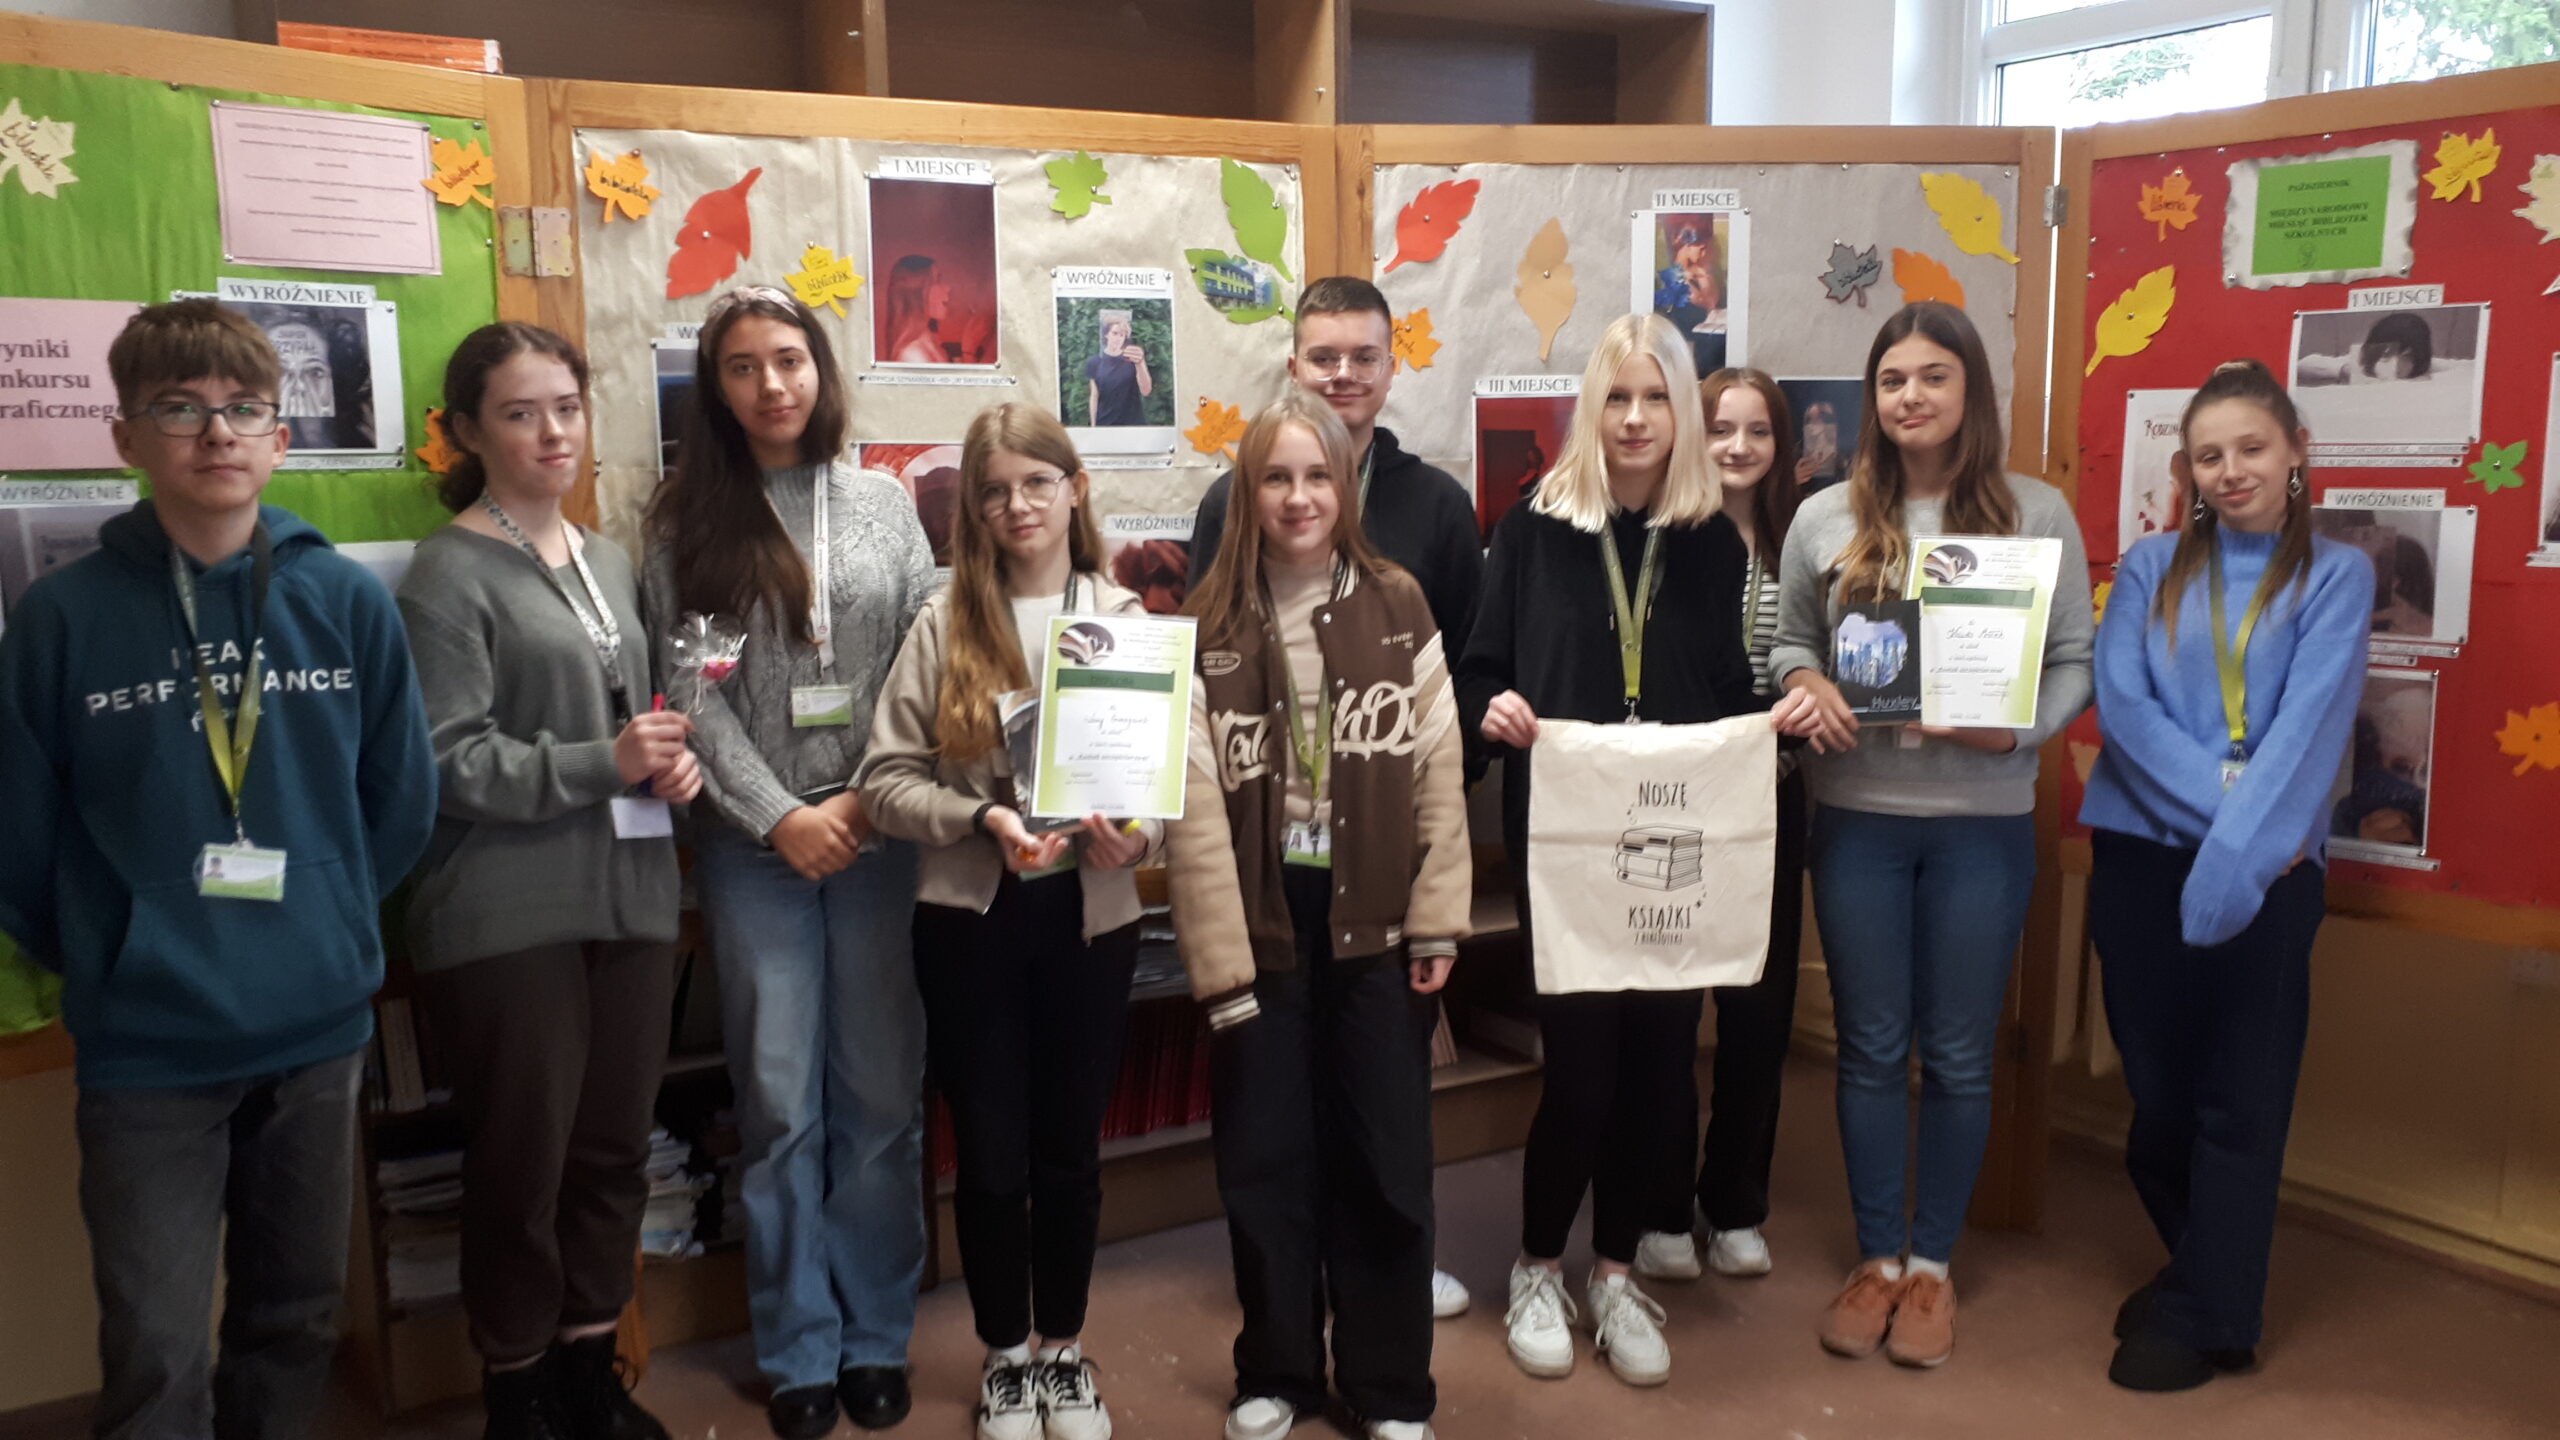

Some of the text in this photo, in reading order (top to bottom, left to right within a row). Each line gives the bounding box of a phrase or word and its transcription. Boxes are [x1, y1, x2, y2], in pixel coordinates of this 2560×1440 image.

[906, 159, 976, 176] MIEJSCE
[1656, 193, 1736, 207] II MIEJSCE
[1066, 271, 1156, 287] WYRÓŻNIENIE
[2363, 288, 2438, 306] MIEJSCE
[0, 339, 70, 362] yniki
[1489, 379, 1573, 392] III MIEJSCE
[0, 400, 124, 423] raficzneg
[1638, 780, 1689, 811] NOSZĘ
[1628, 903, 1692, 933] KSIĄŻKI
